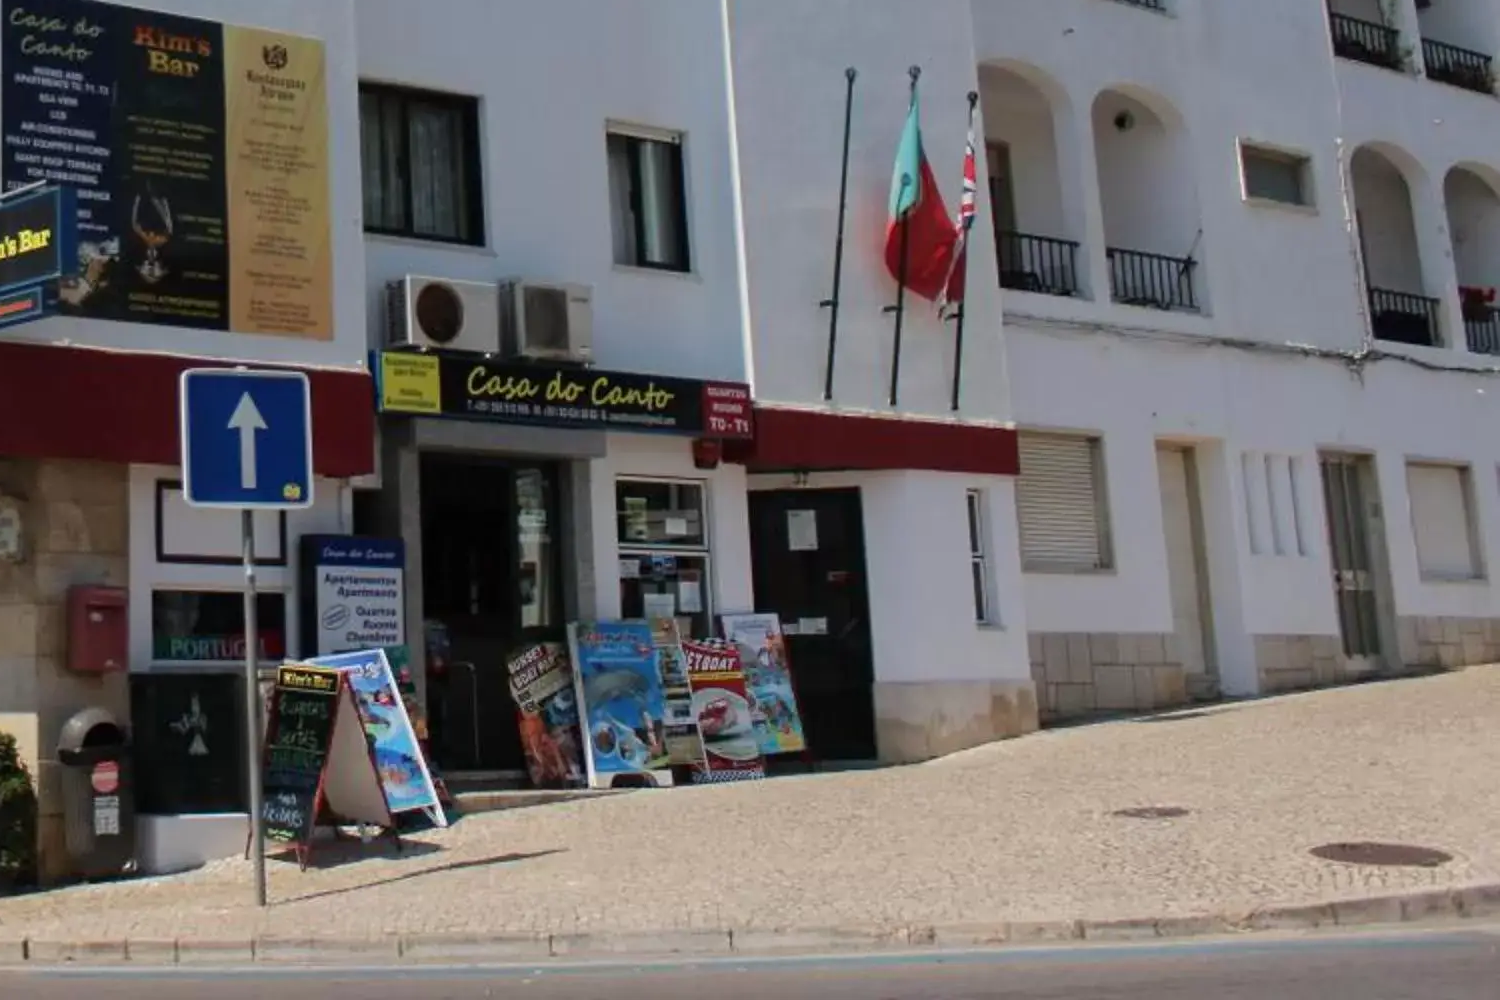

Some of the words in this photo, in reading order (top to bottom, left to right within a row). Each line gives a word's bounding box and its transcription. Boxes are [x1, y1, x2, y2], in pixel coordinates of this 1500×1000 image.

[10, 7, 67, 31] Casa
[73, 17, 105, 37] do
[21, 35, 93, 61] Canto
[133, 25, 212, 57] Kim's
[148, 50, 200, 77] Bar
[18, 228, 51, 253] Bar
[467, 366, 540, 399] Casa
[545, 370, 585, 401] do
[591, 377, 675, 411] Canto
[325, 573, 397, 585] Apartamentos
[356, 605, 397, 616] Quartos
[170, 637, 267, 657] PORTUGL
[684, 650, 738, 671] ETBOAT
